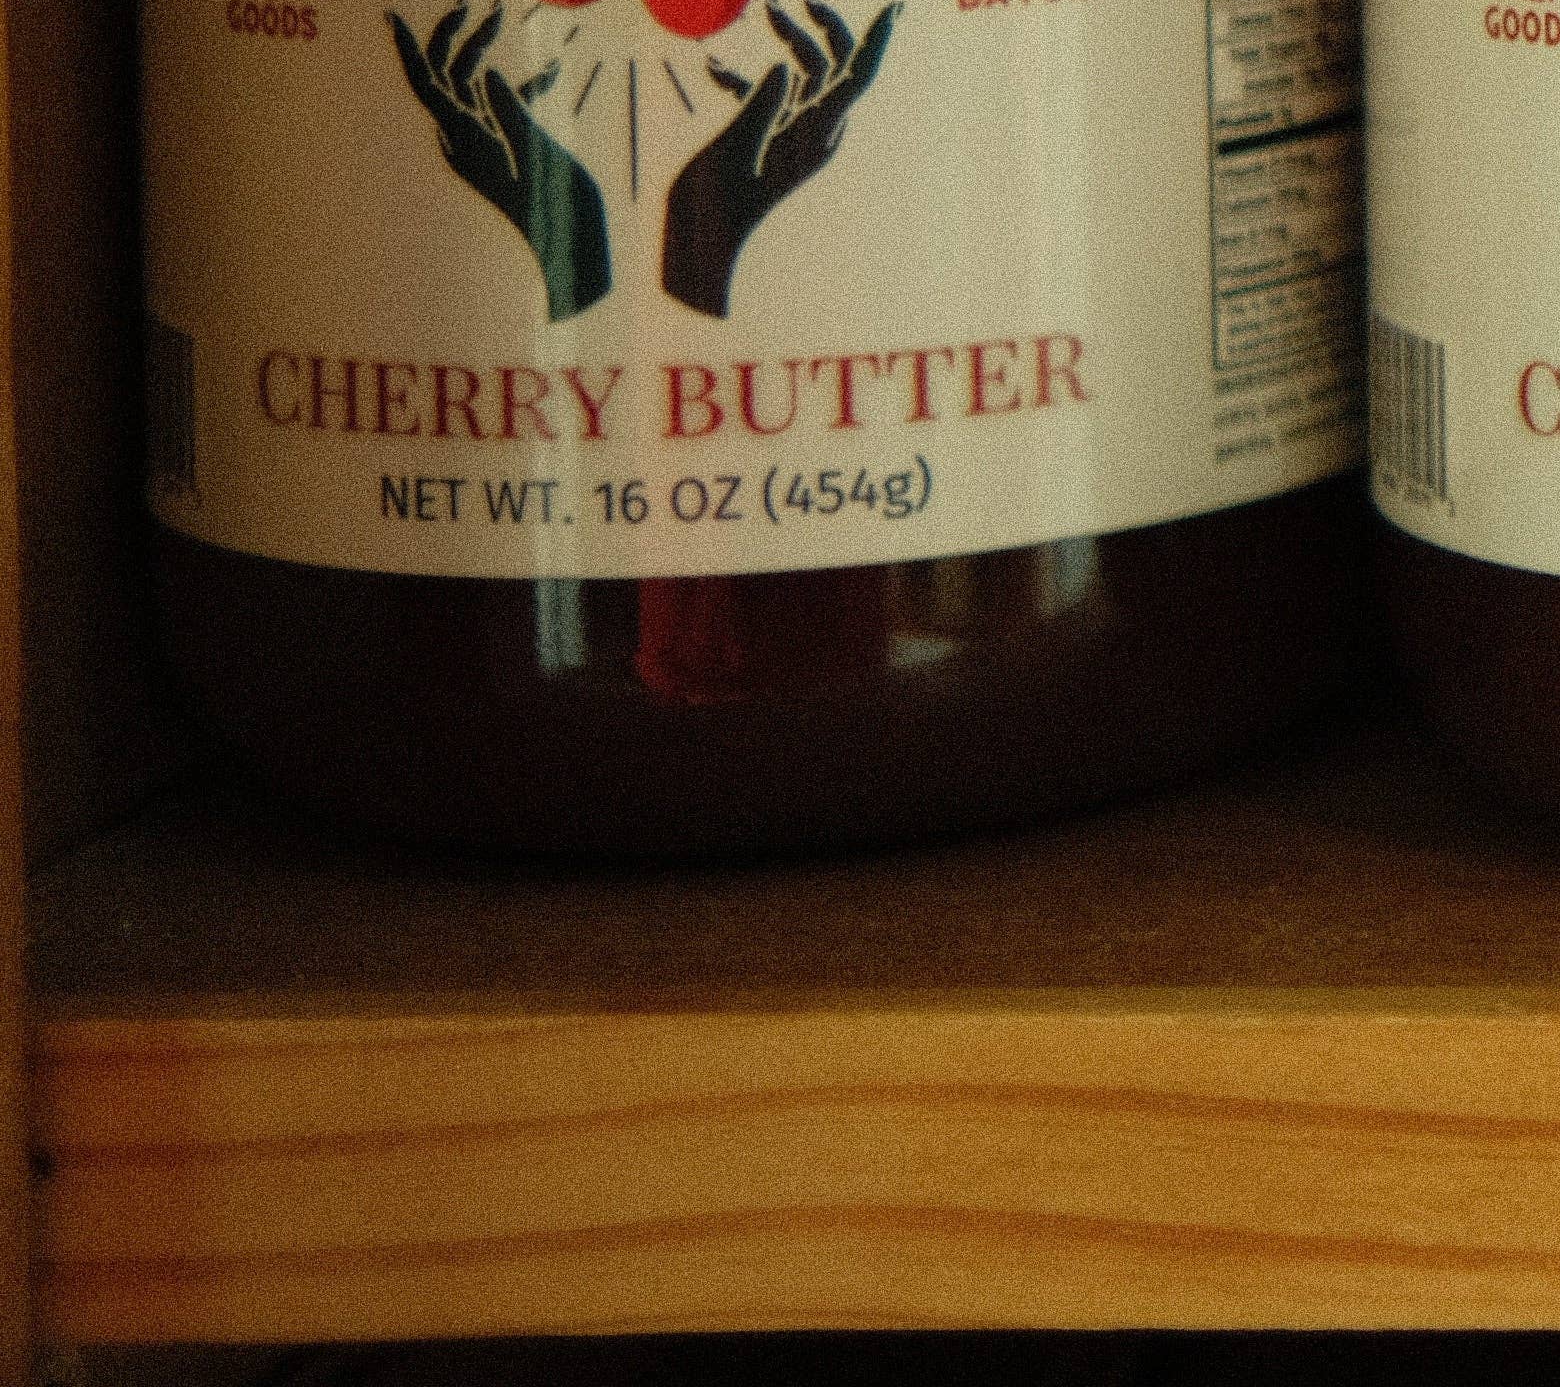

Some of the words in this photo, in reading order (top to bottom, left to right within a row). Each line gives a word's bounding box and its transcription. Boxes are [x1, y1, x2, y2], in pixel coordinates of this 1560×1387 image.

[255, 348, 626, 441] CHERRY
[660, 333, 1091, 439] BUTTER
[378, 476, 466, 525] NET
[484, 480, 575, 525] WT.
[596, 482, 648, 525] 16
[669, 476, 744, 523] OZ
[761, 458, 935, 525] (454g)
